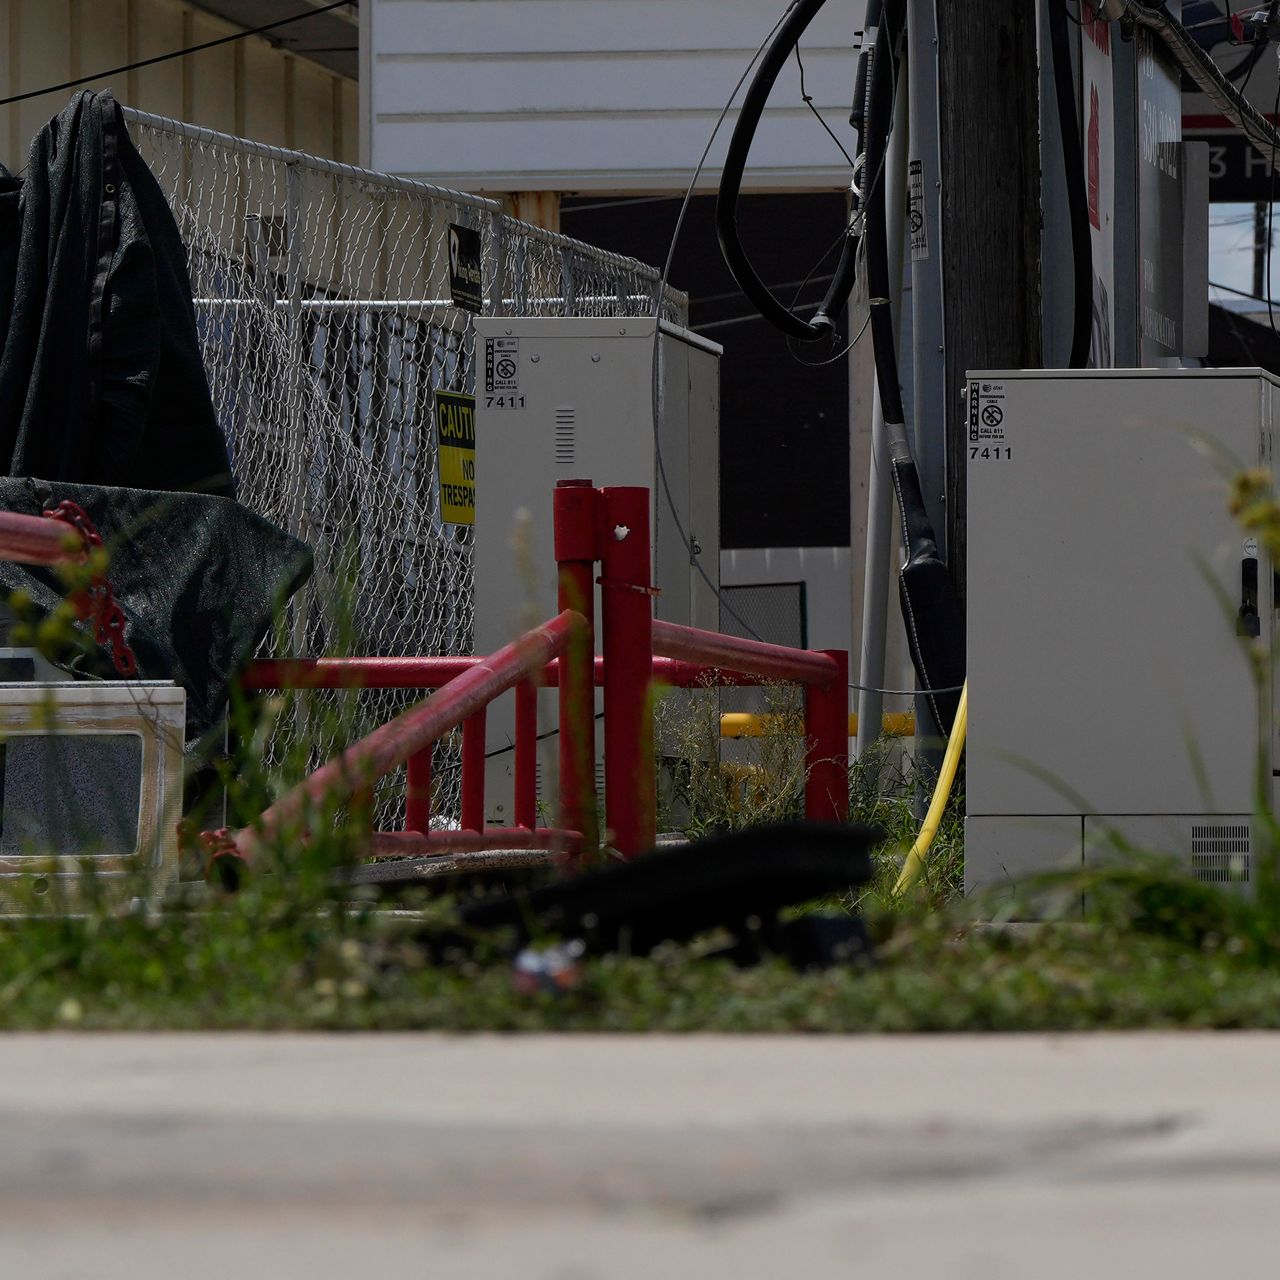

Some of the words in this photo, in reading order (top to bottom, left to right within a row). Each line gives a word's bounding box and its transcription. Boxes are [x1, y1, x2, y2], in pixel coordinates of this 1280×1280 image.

[486, 339, 494, 391] WARNING
[486, 396, 525, 408] 7411
[970, 382, 979, 440] WARNING
[439, 403, 475, 440] CAUTI
[969, 447, 1011, 460] 7411
[462, 459, 475, 480] NO
[442, 483, 475, 508] TRESPA
